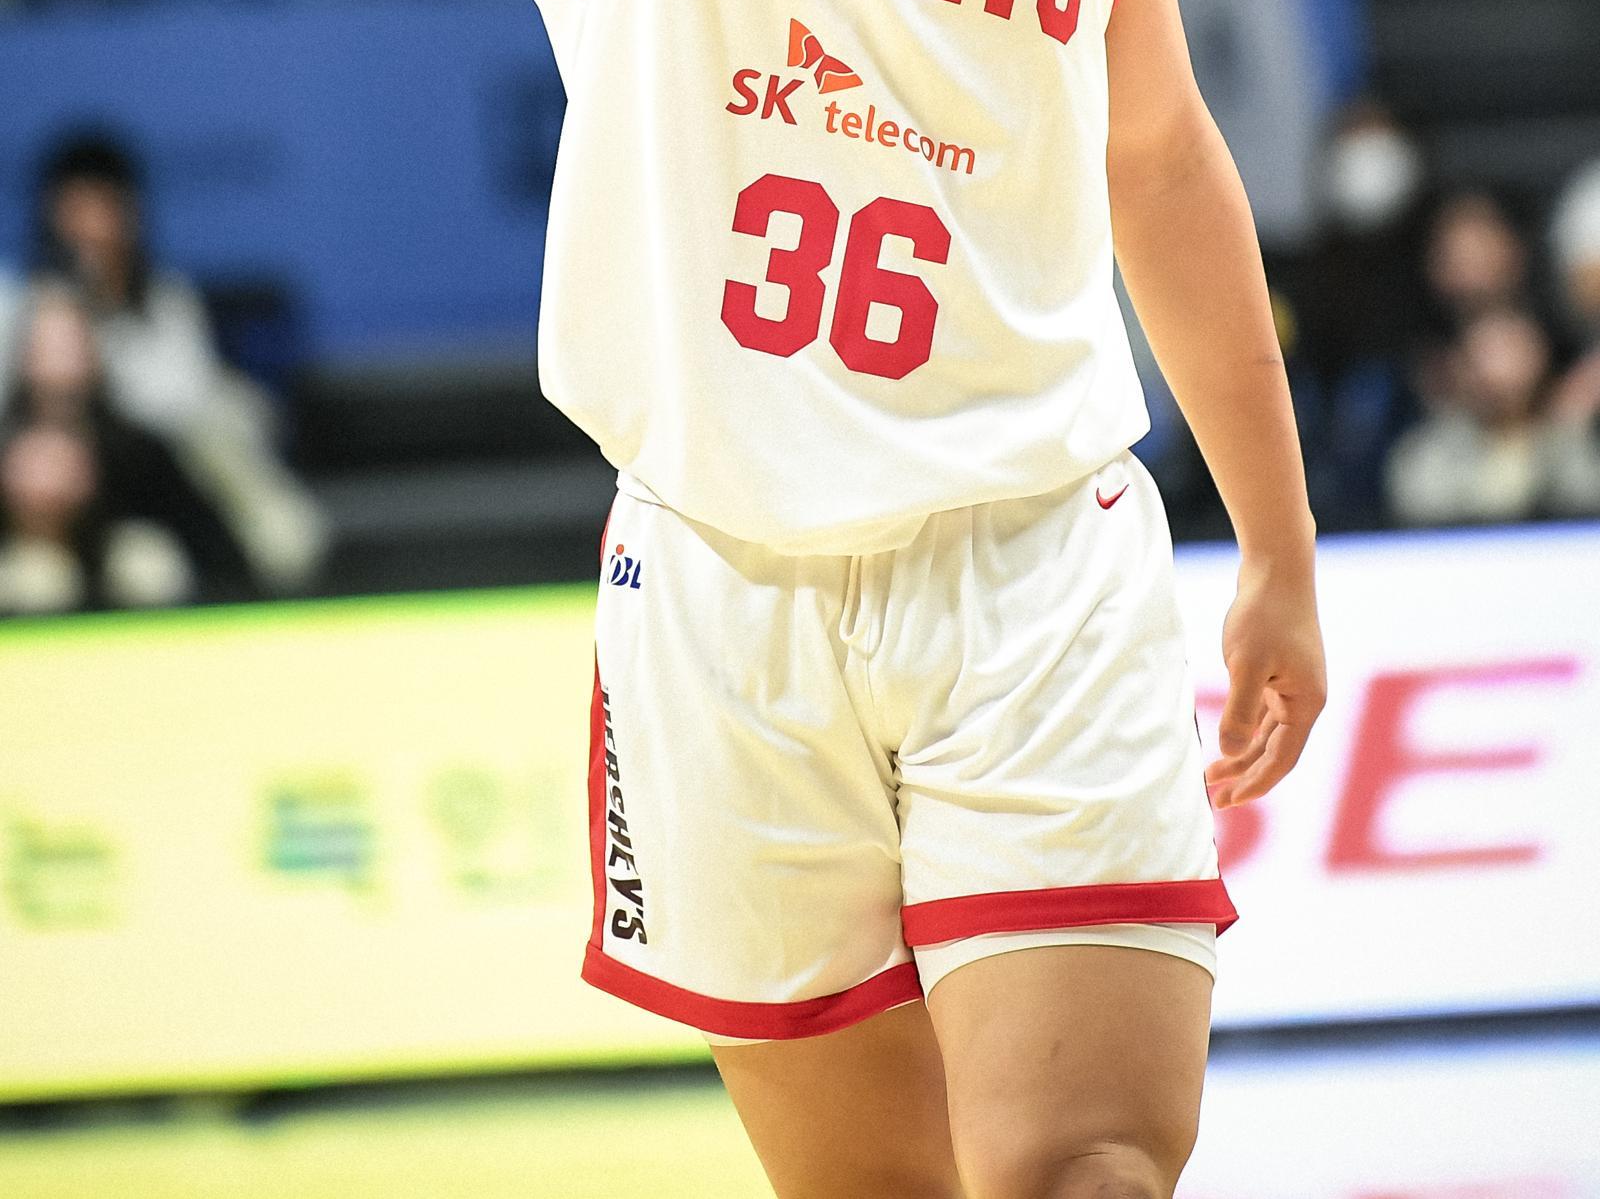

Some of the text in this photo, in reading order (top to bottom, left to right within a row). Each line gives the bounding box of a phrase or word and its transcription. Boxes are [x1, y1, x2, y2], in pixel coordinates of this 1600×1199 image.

[725, 68, 976, 175] SK telecom
[721, 174, 951, 381] 36
[607, 554, 641, 589] BL
